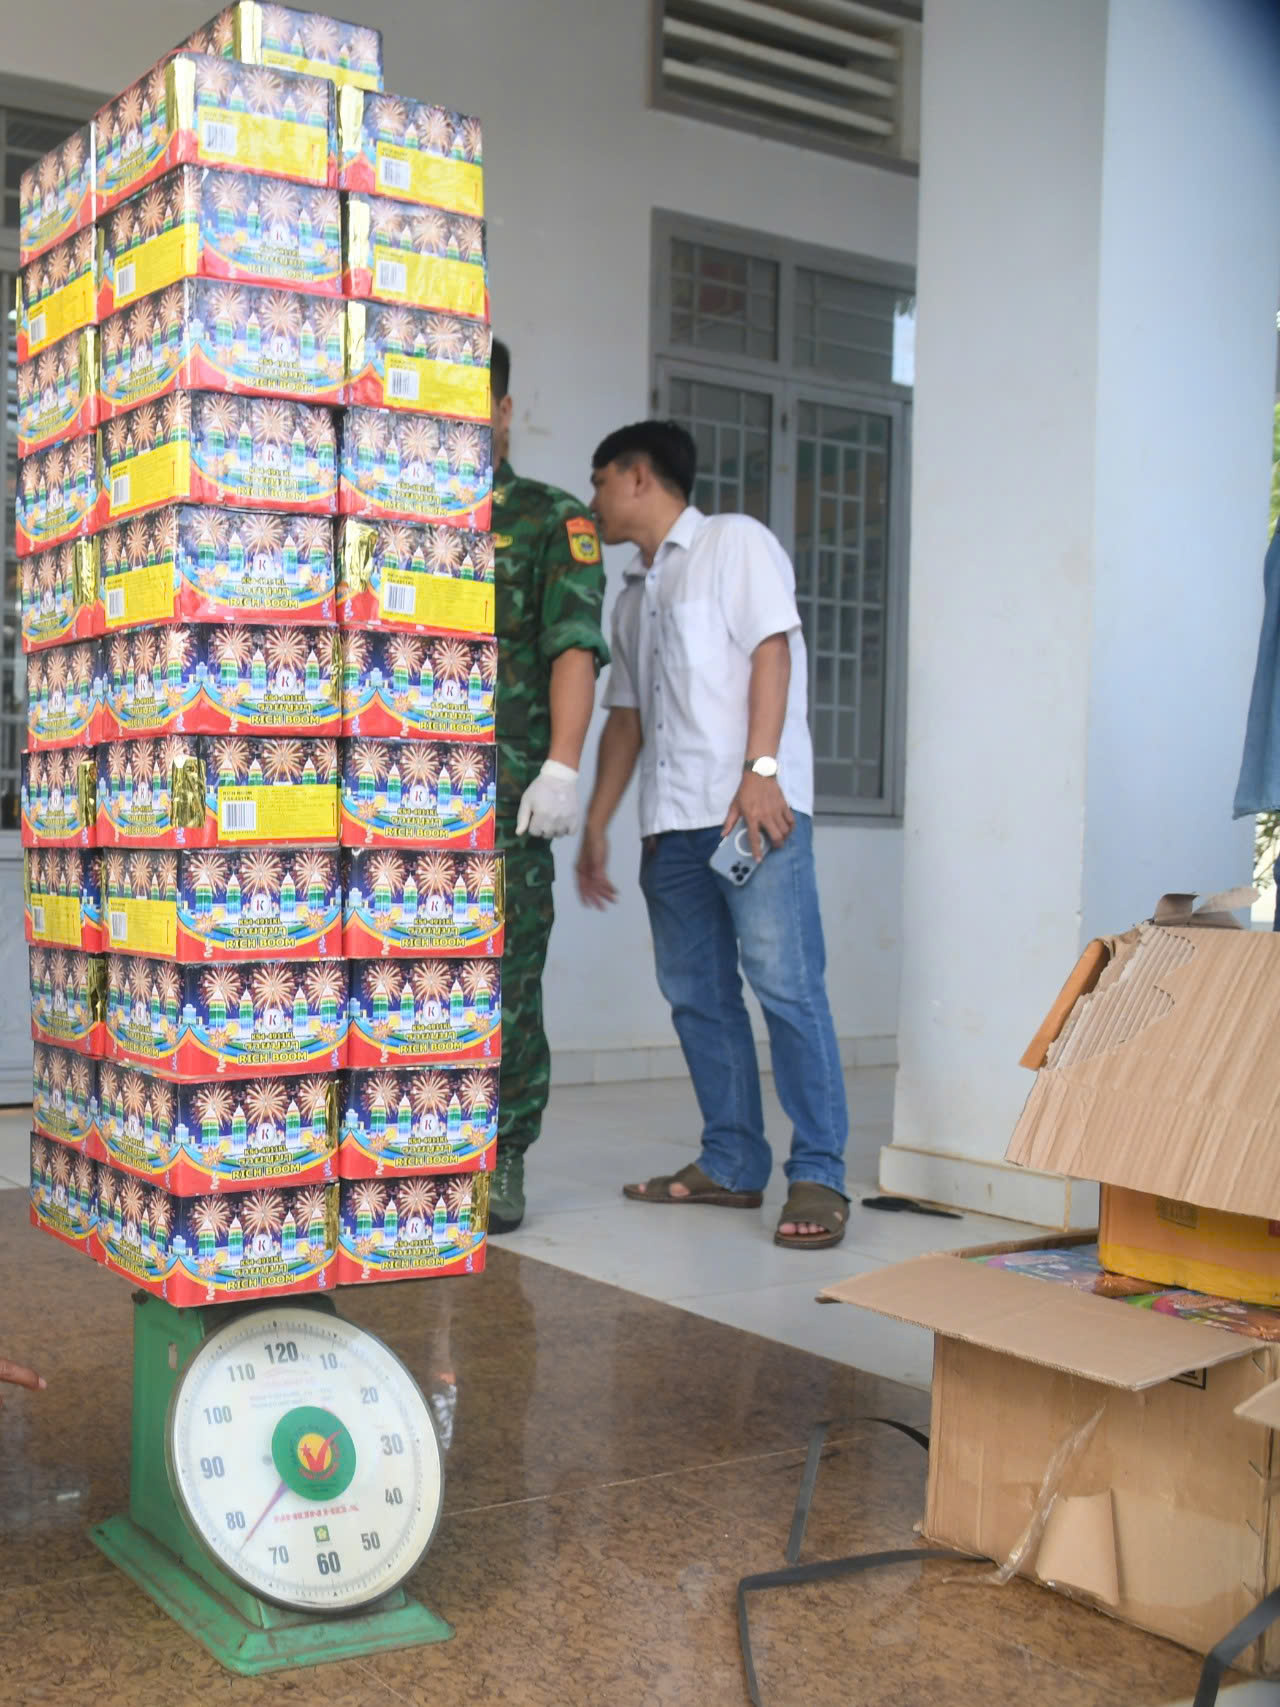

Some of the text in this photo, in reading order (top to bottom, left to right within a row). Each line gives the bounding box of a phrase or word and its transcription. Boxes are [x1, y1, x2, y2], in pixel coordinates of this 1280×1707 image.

[250, 714, 319, 724] RICH BOOM
[449, 722, 480, 733] BOOM
[384, 827, 449, 837] RICH BOOM
[225, 936, 295, 949] RICH BOOM
[400, 936, 465, 947] RICH BOOM
[399, 1040, 463, 1054] RICH BOOM
[238, 1050, 307, 1064] RICH BOOM
[394, 1153, 458, 1167] RICH BOOM
[231, 1161, 300, 1180] RICH BOOM
[381, 1255, 444, 1270] RICH BOOM
[227, 1272, 294, 1290] RICH BOOM
[265, 1342, 299, 1364] 120
[320, 1353, 338, 1371] 10
[228, 1363, 255, 1383] 110
[361, 1386, 379, 1404] 20
[204, 1406, 232, 1425] 100
[381, 1434, 404, 1455] 30
[200, 1456, 225, 1479] 90
[385, 1487, 403, 1505] 40
[226, 1511, 246, 1530] 80
[361, 1531, 381, 1551] 50
[269, 1545, 289, 1565] 70
[317, 1552, 341, 1576] 60
